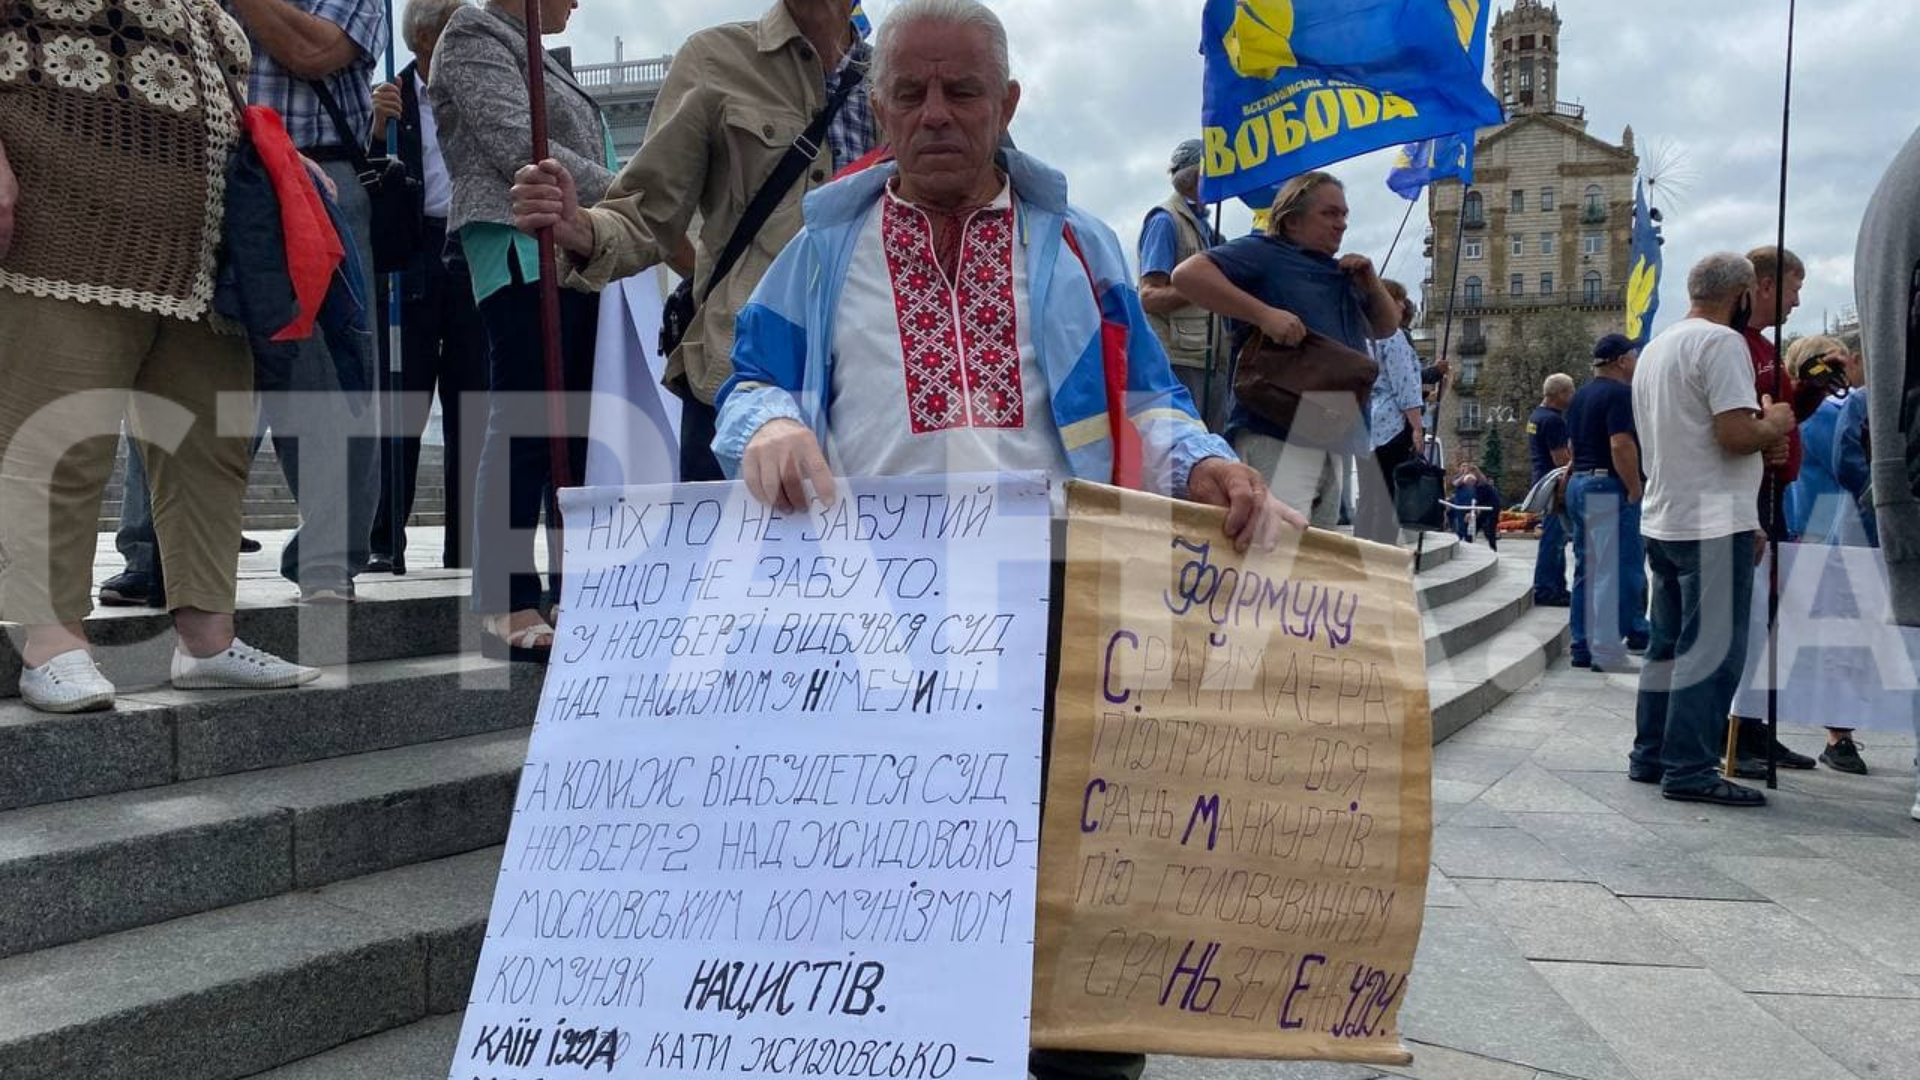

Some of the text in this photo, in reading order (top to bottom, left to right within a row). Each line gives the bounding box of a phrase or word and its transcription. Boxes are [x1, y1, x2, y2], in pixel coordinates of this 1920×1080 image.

[1200, 88, 1418, 177] ВОБОДА
[587, 485, 996, 551] НІХТО НЕ ЗАБУТИЙ
[576, 556, 941, 612] НІЩО НЕ ЗАБУТО.
[1163, 536, 1358, 648] ФОРМУЛУ
[564, 606, 1017, 664] У НЮРБЕРЗІ ВІДБУВСЯ СУД
[550, 676, 610, 722] НАД
[624, 669, 773, 719] НАЦИЗМОМ
[525, 761, 549, 811] А
[702, 744, 921, 808] ВІДБУДЕТСЯ
[921, 752, 1009, 806] СУД
[1091, 704, 1372, 800] ПІДТРИМУЄ ВСЯ
[1080, 777, 1175, 840] СРАНЬ
[518, 822, 701, 872] НЮРБЕРГ-2
[717, 820, 784, 870] НАД
[1075, 848, 1136, 906] ПІД
[501, 881, 1013, 944] МОСКОВСЬКИМ КОМУНІЗМОМ
[486, 951, 887, 1021] КОМУНЯК НАЦИСТІВ.
[470, 1018, 543, 1067] КАЇН
[645, 1032, 732, 1072] КАТИ
